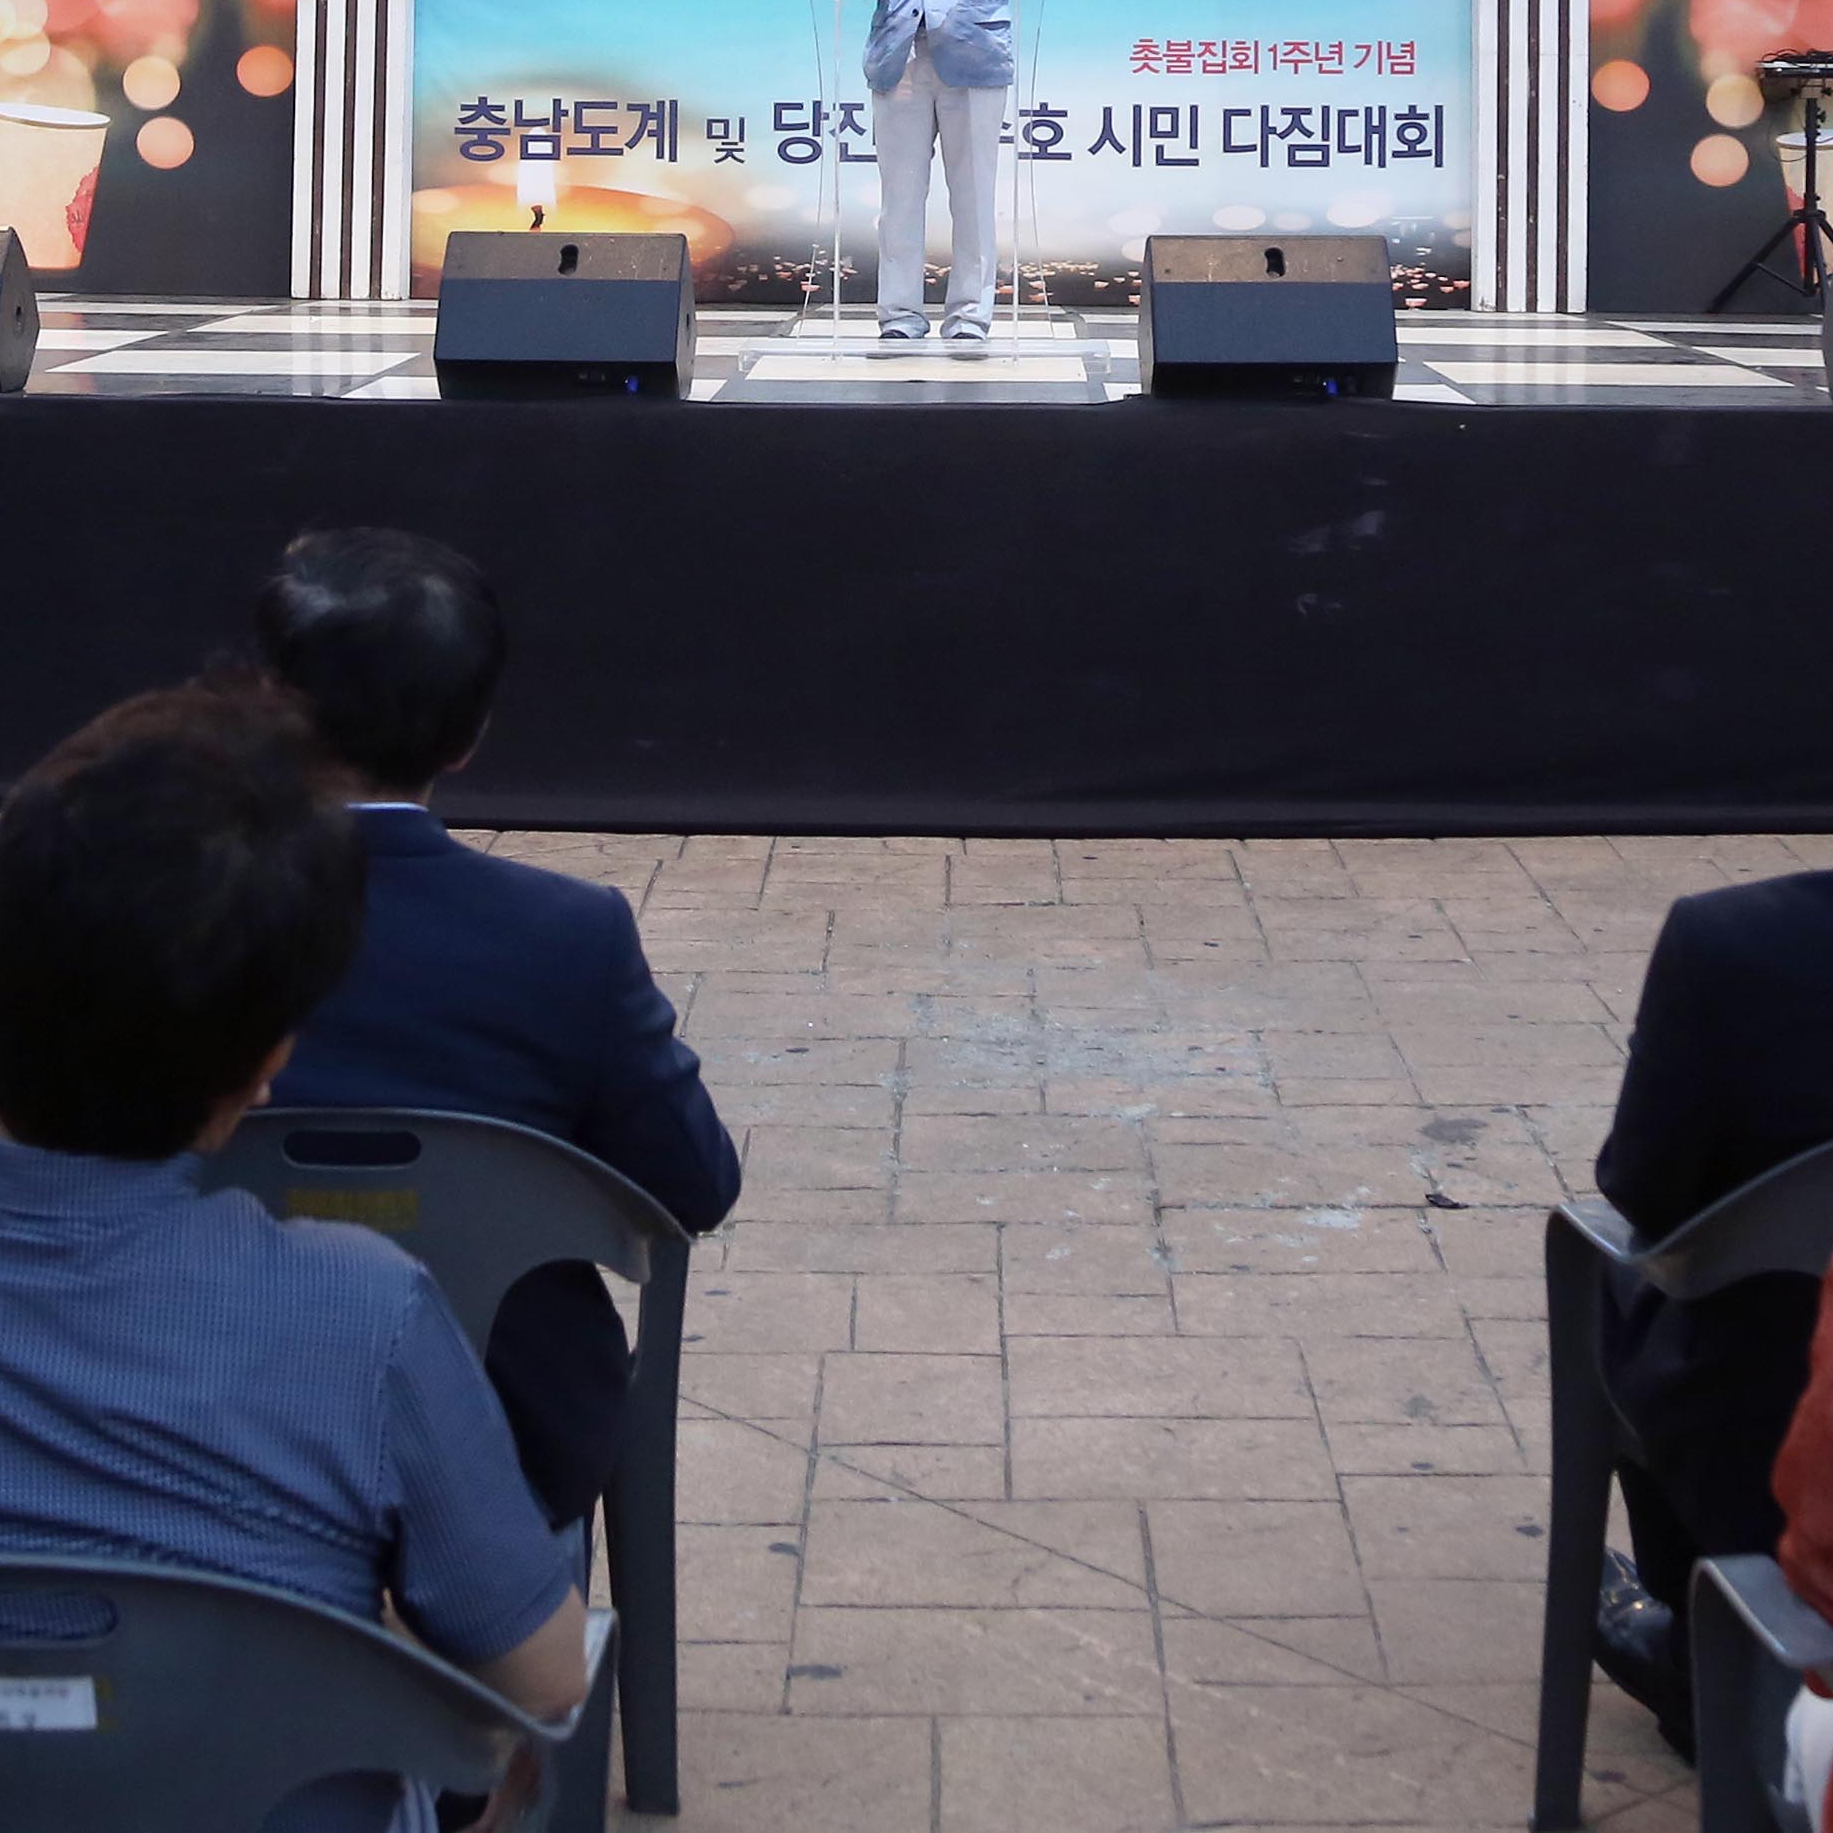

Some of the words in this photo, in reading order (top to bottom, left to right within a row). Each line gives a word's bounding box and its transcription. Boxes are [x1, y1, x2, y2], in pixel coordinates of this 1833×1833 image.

[1129, 38, 1261, 75] 촛불집회
[1268, 40, 1345, 76] 1주년
[1354, 40, 1417, 75] 기념
[454, 96, 679, 163] 충남도계
[705, 116, 746, 165] 및
[1087, 103, 1201, 167] 시민
[1222, 103, 1445, 169] 다짐대회
